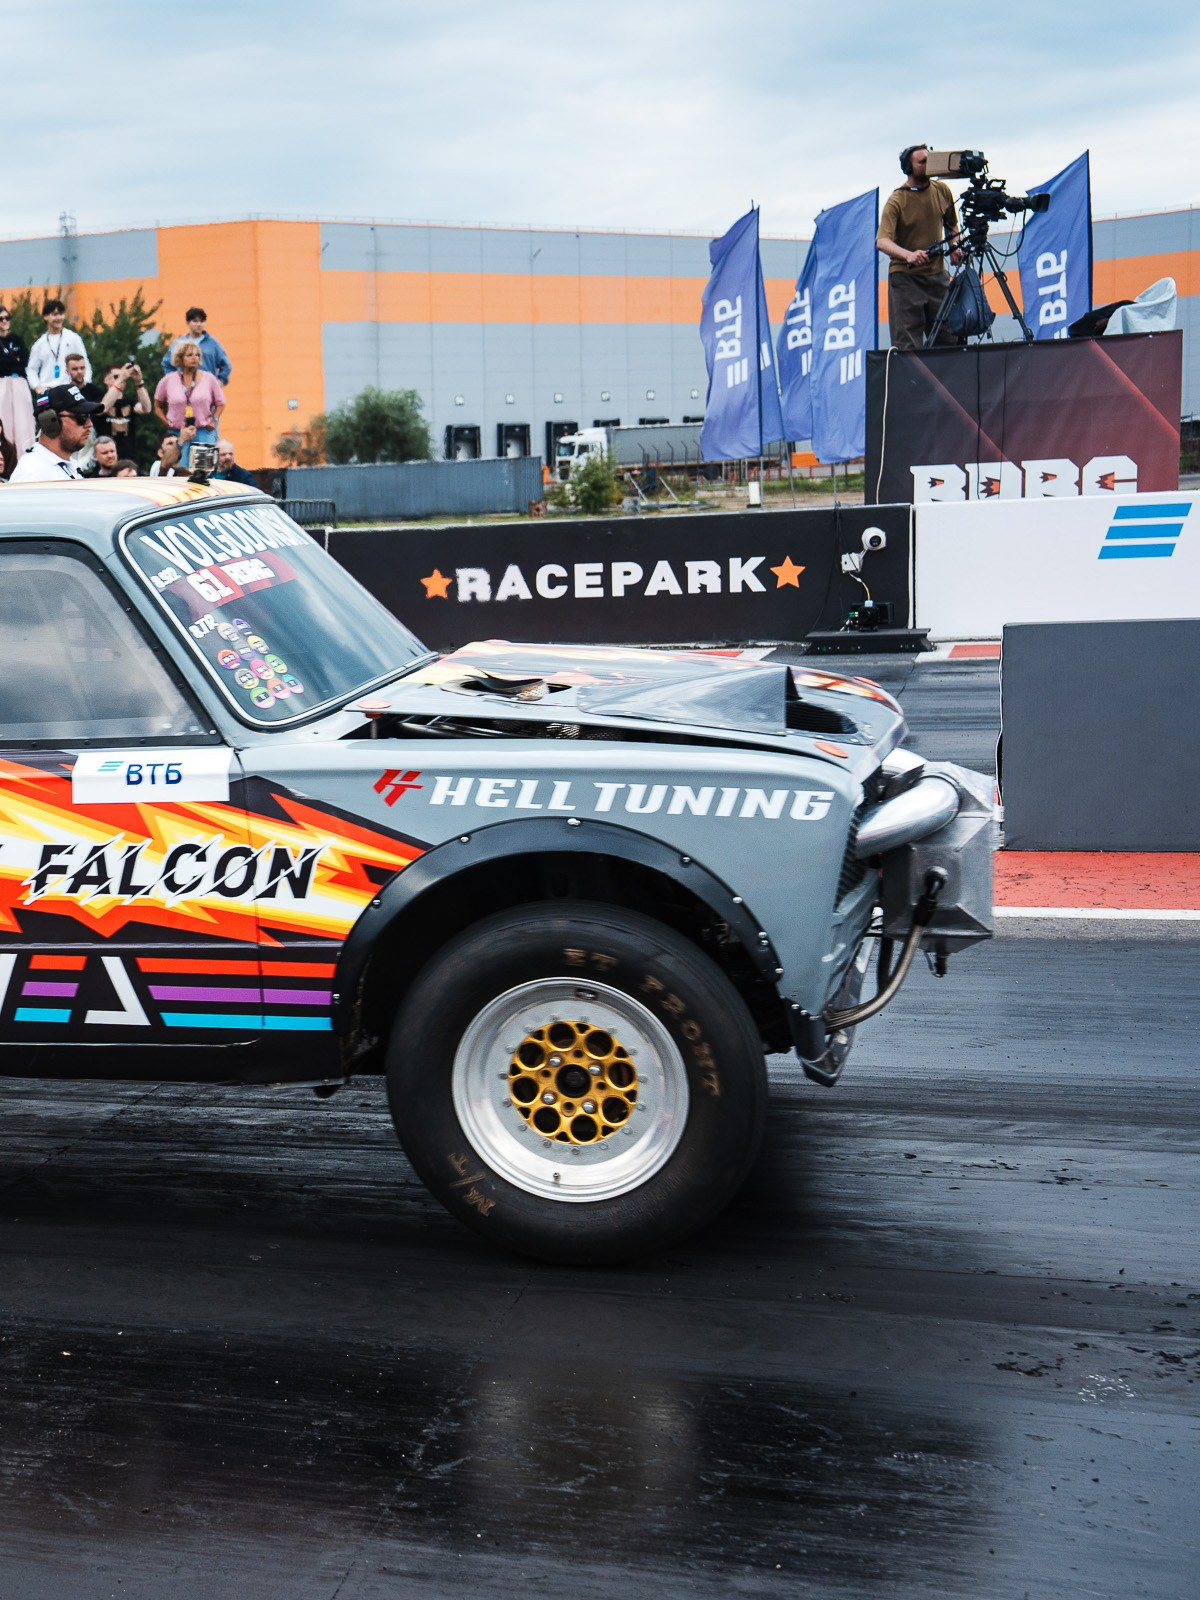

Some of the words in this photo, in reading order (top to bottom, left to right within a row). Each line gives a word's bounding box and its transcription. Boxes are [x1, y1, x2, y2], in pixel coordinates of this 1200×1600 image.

[186, 568, 236, 603] 61
[455, 556, 767, 602] RACEPARK
[126, 763, 183, 785] ВТБ
[429, 776, 576, 811] HELL
[593, 782, 836, 821] TUNING
[30, 842, 320, 899] FALCON
